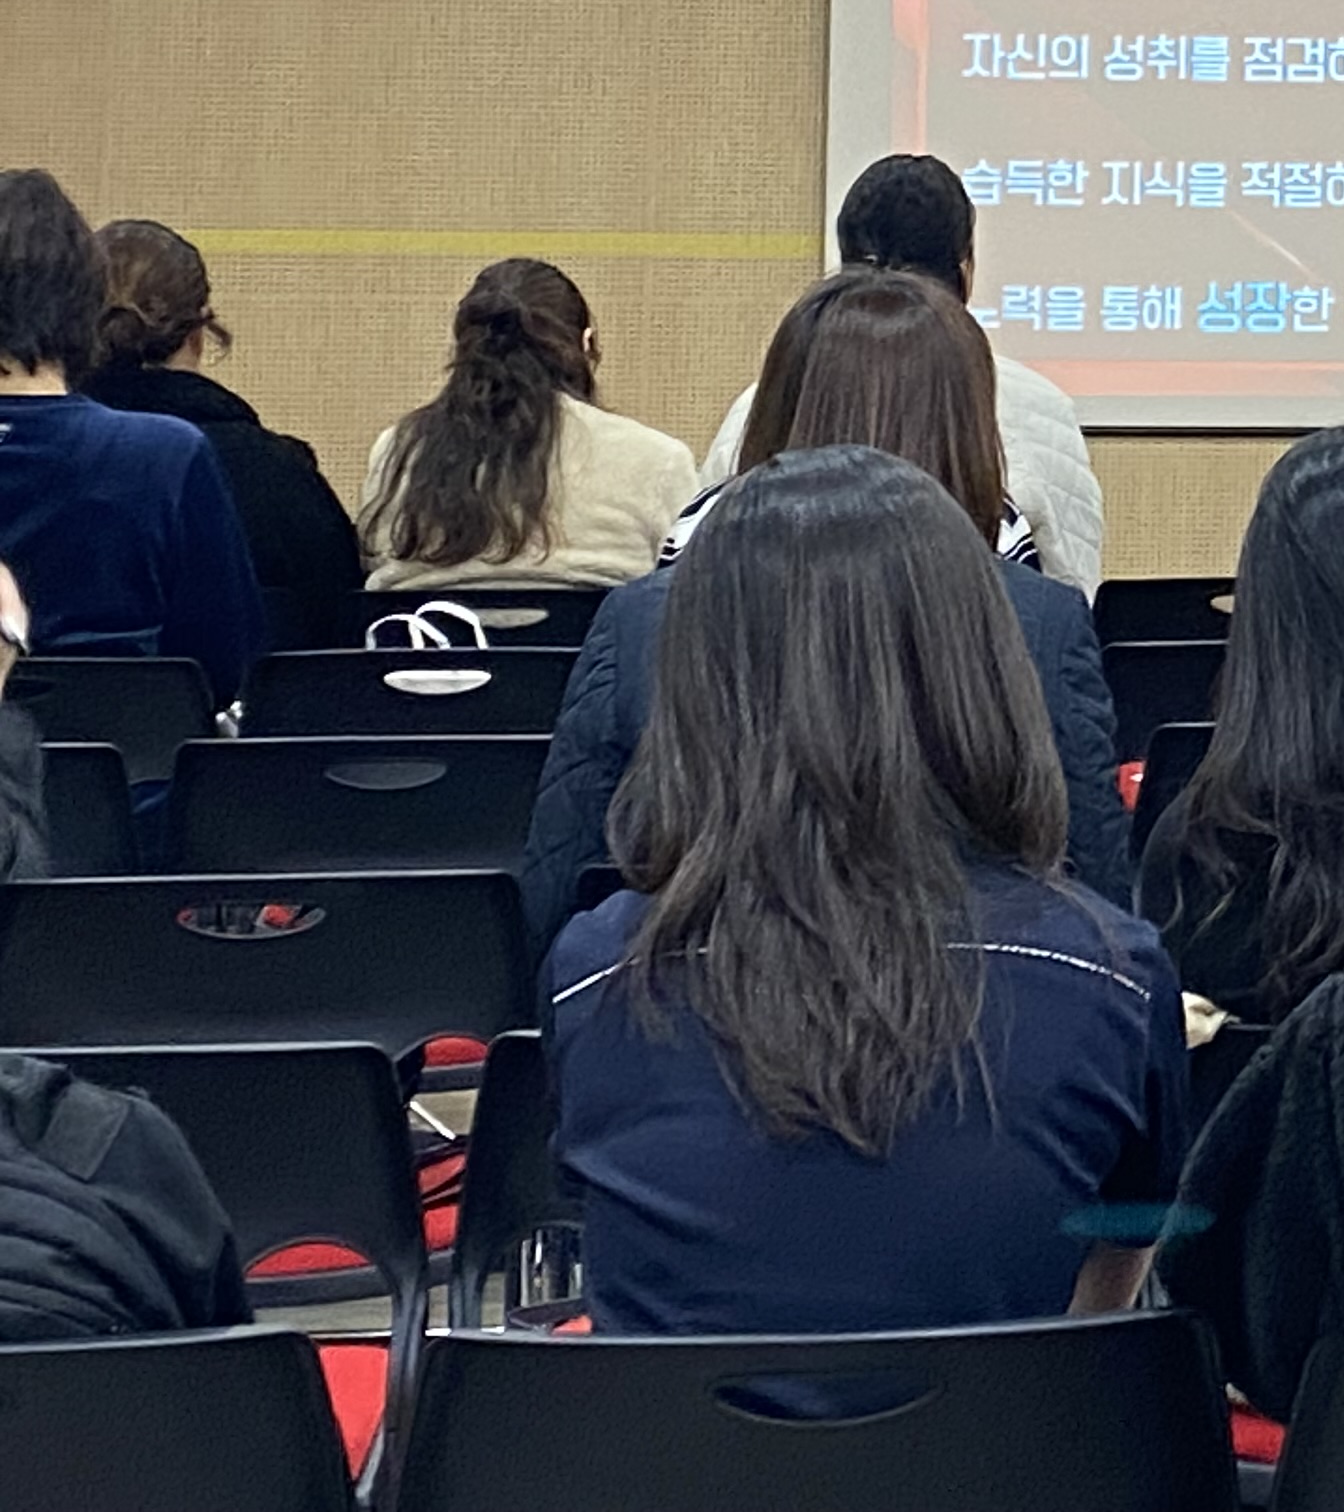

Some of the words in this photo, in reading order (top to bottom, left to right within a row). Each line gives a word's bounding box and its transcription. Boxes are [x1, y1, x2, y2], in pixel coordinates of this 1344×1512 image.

[961, 32, 1090, 81] 자신의
[1103, 34, 1231, 83] 성취를
[962, 157, 1089, 208] 습득한
[1101, 159, 1228, 208] 지식을
[1099, 284, 1184, 332] 통해
[1197, 280, 1335, 334] 성장한
